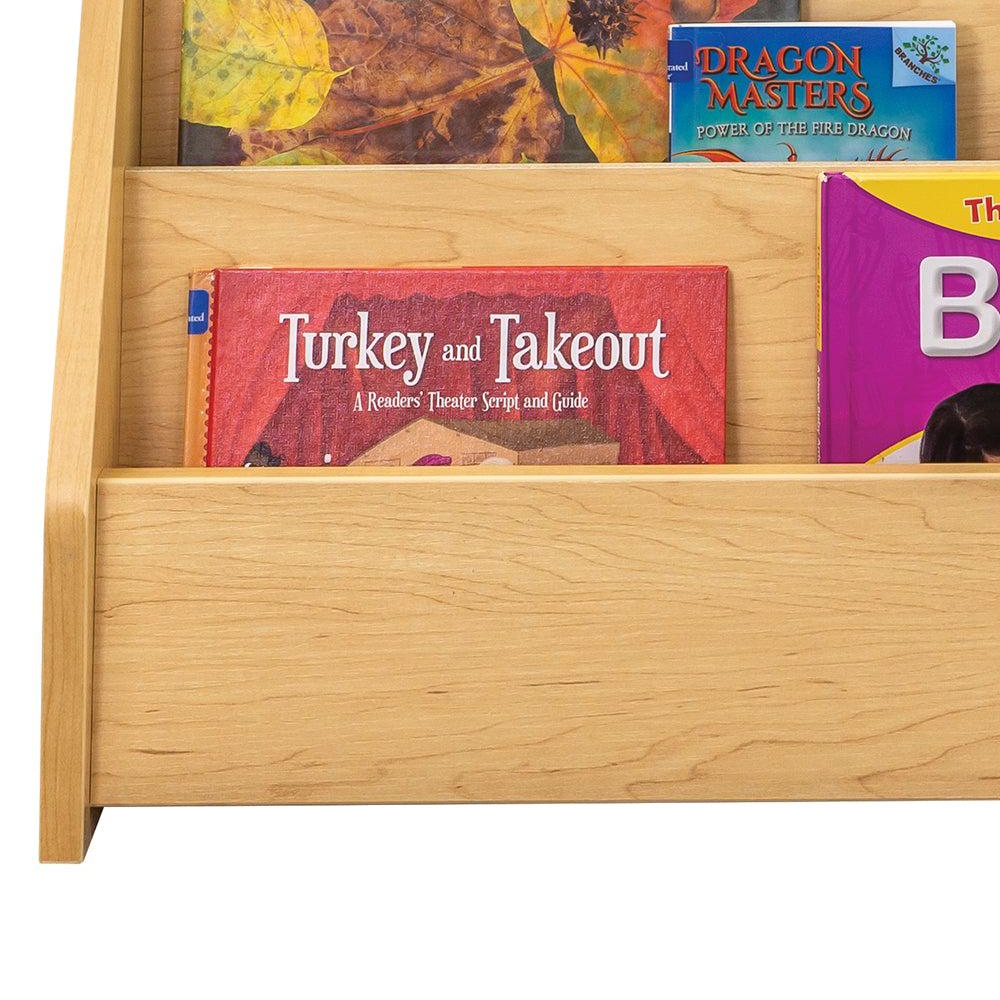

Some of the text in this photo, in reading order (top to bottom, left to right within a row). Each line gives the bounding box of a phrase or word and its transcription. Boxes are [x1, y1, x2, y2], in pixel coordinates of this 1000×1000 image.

[696, 41, 863, 80] DRAGON
[894, 46, 939, 85] BRANCHES
[701, 77, 874, 119] MASTERS
[697, 121, 912, 141] POWER OF THE FIRE DRAGON
[280, 311, 669, 386] Turkey and Takeout
[354, 391, 588, 411] A Readers' Theater Script and Guide
